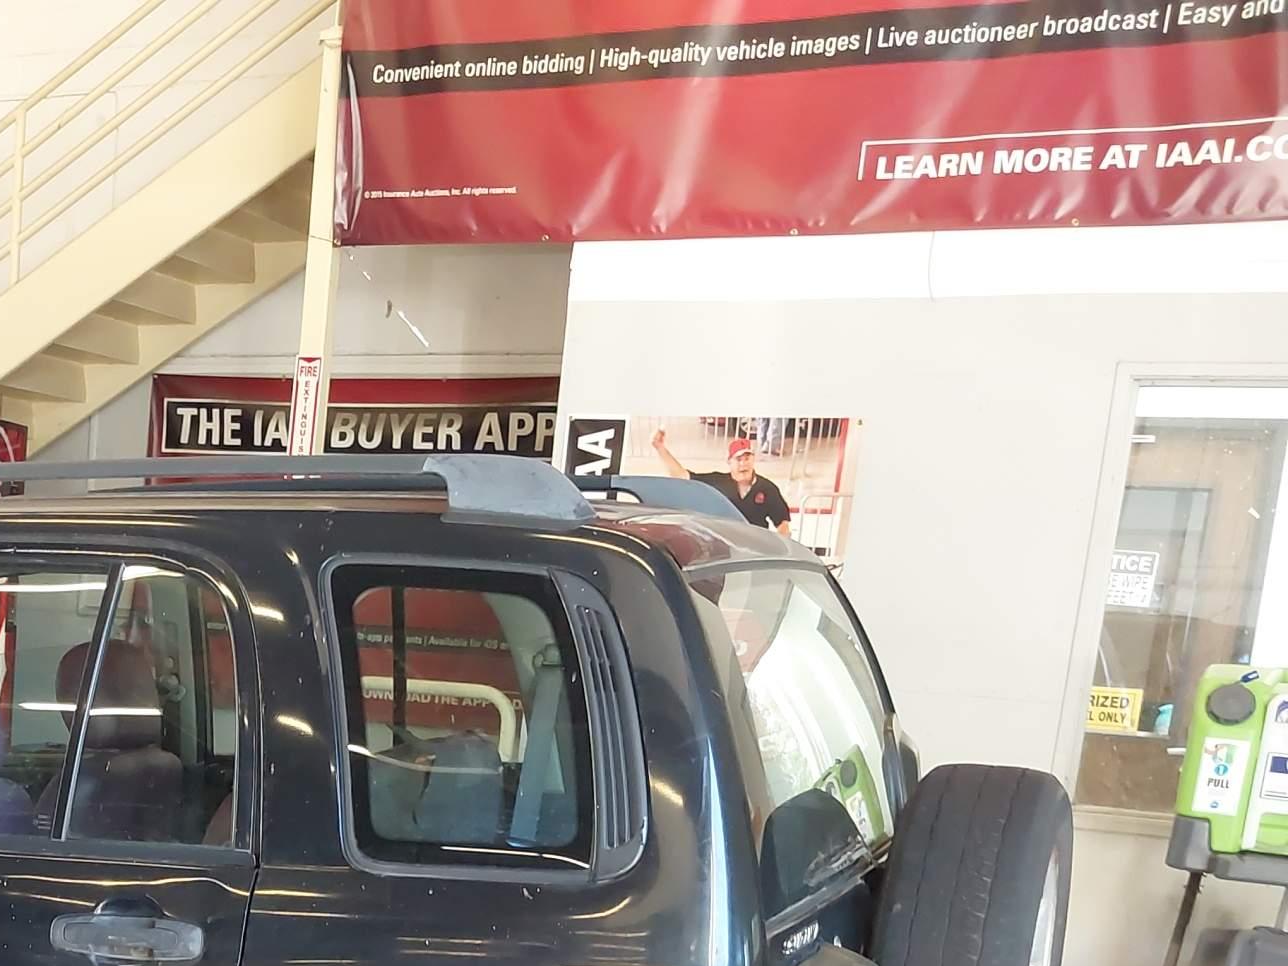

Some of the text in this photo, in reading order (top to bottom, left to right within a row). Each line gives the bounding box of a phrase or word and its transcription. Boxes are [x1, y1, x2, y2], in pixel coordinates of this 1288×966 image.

[372, 60, 461, 84] Convenient
[465, 56, 518, 78] online
[522, 52, 585, 76] bidding
[600, 40, 713, 70] High-quality
[716, 35, 785, 60] vehicle
[790, 33, 860, 57] images
[877, 26, 920, 48] Live
[924, 17, 1038, 45] auctioneer
[1043, 8, 1159, 36] broadcast
[1177, 1, 1236, 28] Easy
[1241, 0, 1284, 18] and
[875, 151, 983, 180] LEARN
[993, 146, 1094, 174] MORE
[1100, 143, 1147, 170] AT
[299, 365, 319, 378] FIRE
[299, 380, 312, 456] EXTINGUIS
[176, 407, 556, 452] THE IA BUYER APP
[1111, 554, 1153, 572] TICE
[1089, 694, 1130, 709] RIZED
[1098, 711, 1127, 724] ONLY
[1207, 777, 1231, 789] PULL
